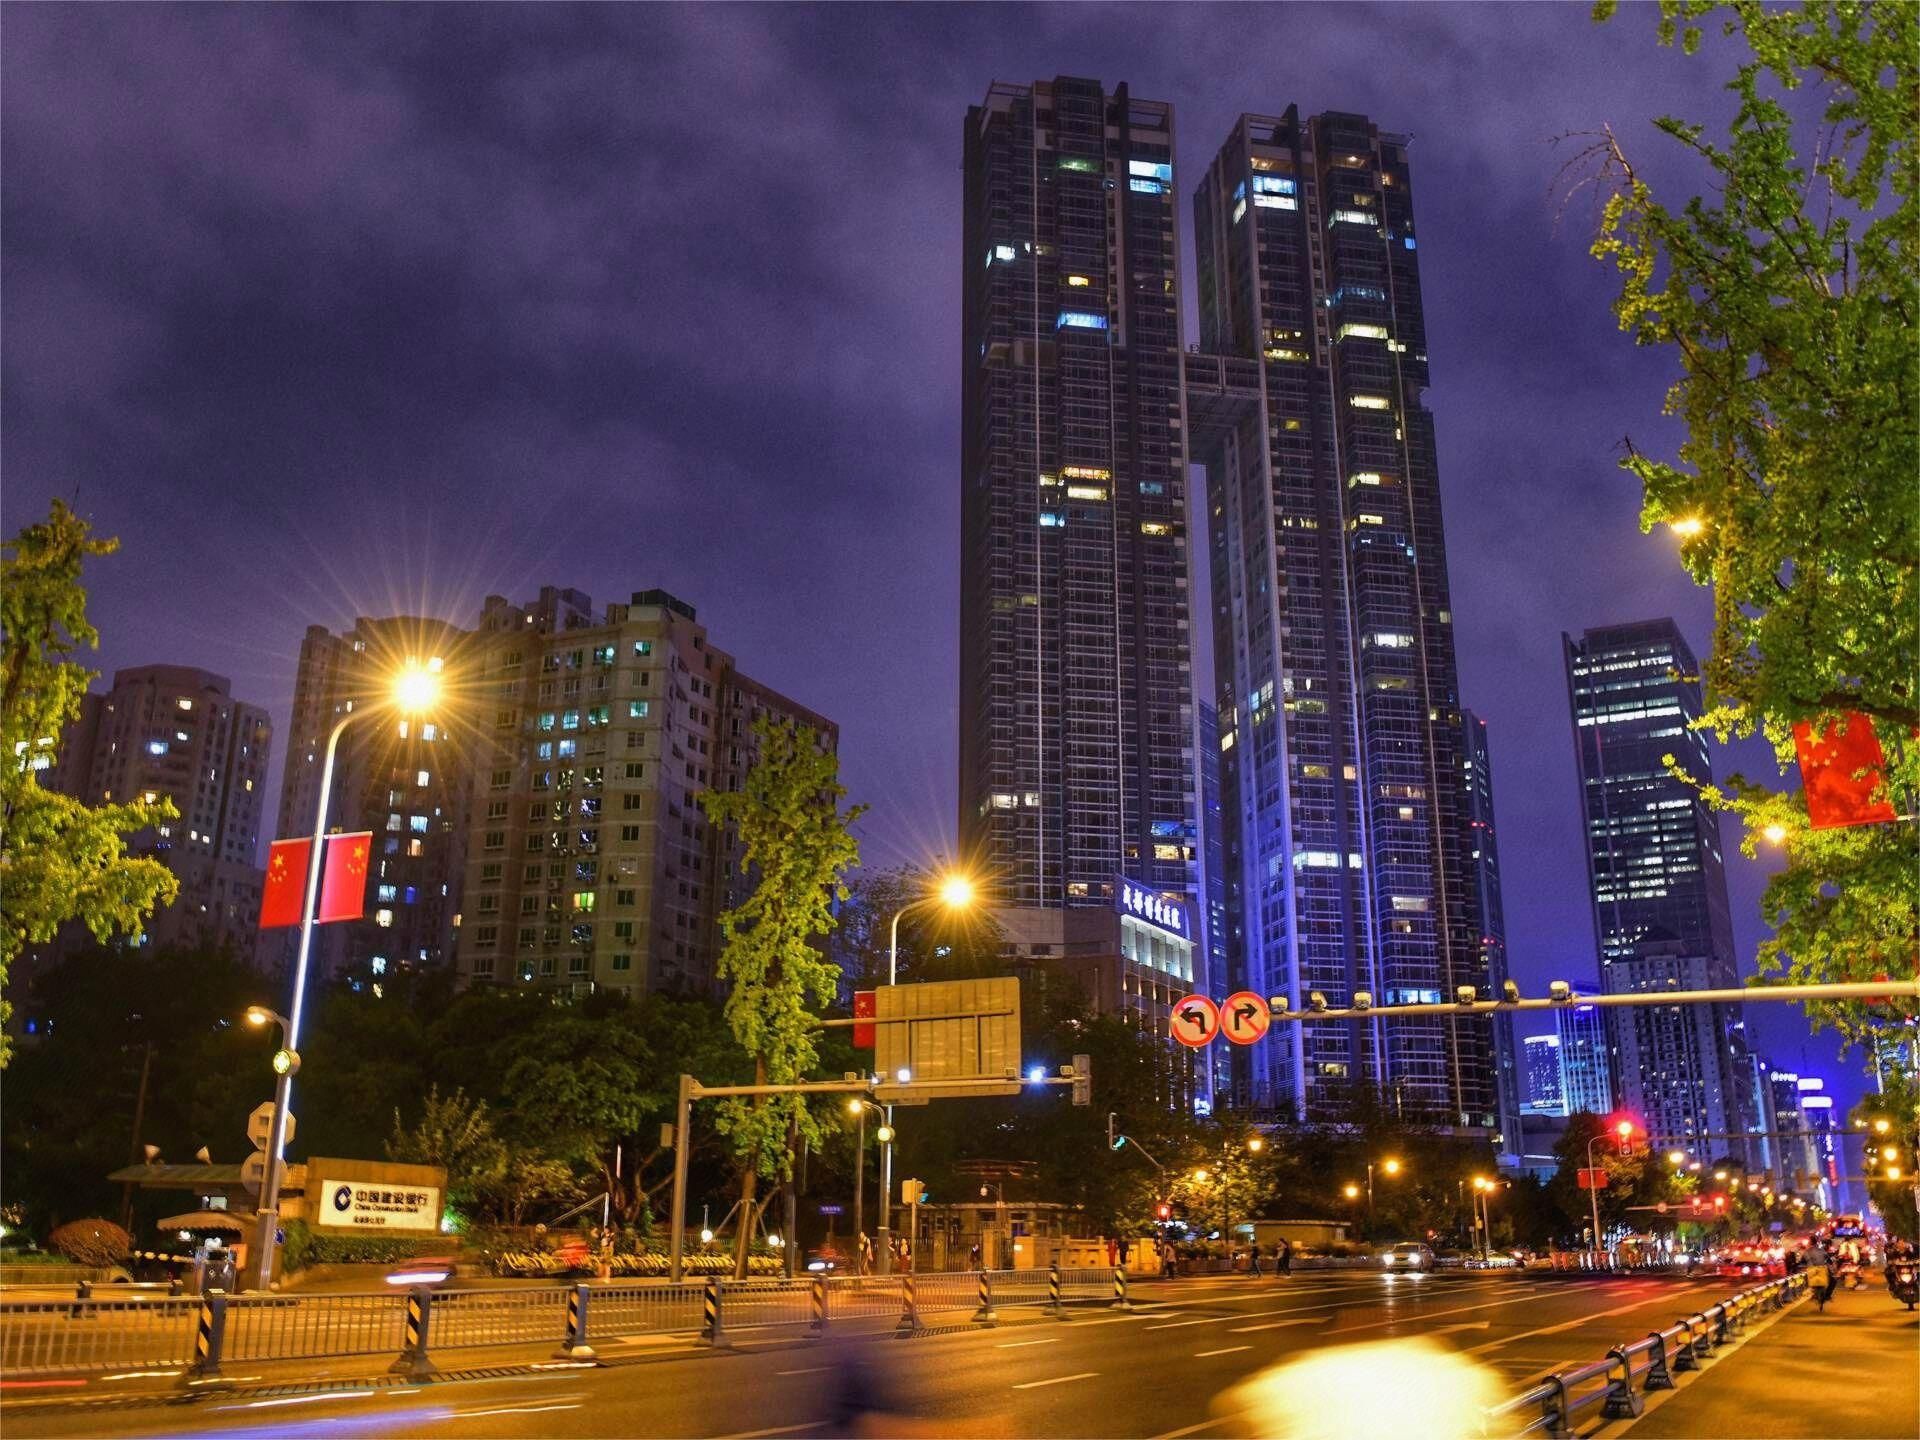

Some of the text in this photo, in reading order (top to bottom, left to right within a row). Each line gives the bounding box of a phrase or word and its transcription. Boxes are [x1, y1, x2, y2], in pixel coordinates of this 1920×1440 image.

[356, 1190, 428, 1206] 中国建设银行
